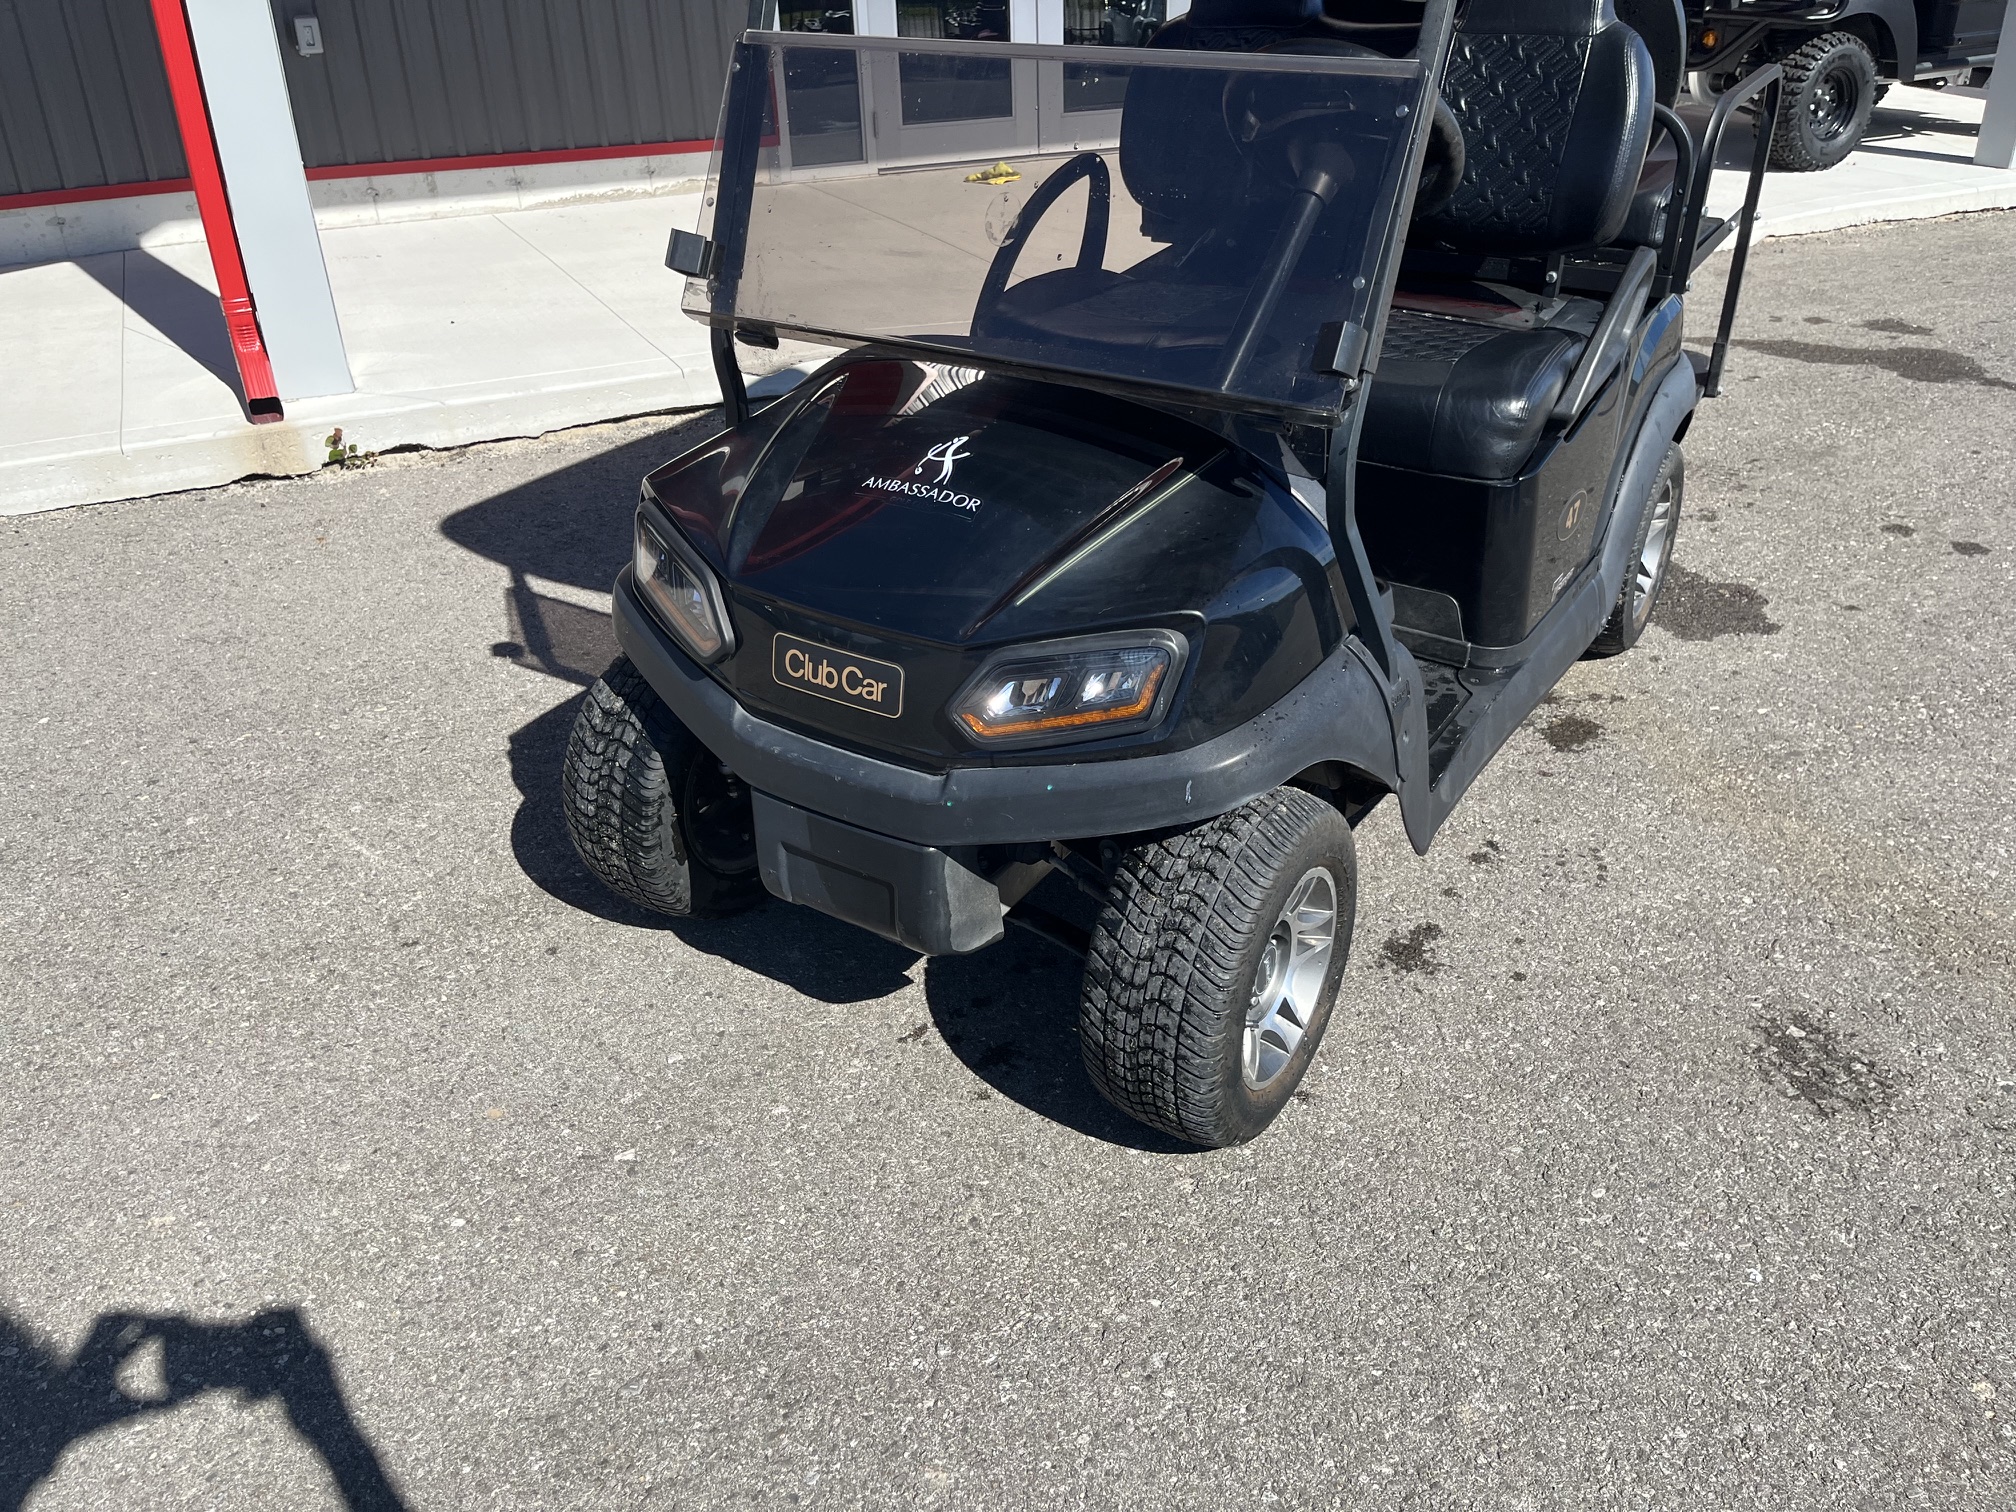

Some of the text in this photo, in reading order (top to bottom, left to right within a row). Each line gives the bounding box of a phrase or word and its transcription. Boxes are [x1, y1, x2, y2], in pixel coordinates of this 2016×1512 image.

[862, 476, 981, 511] AMBASSADOR
[1565, 499, 1581, 529] 47
[785, 649, 887, 702] Club Car
